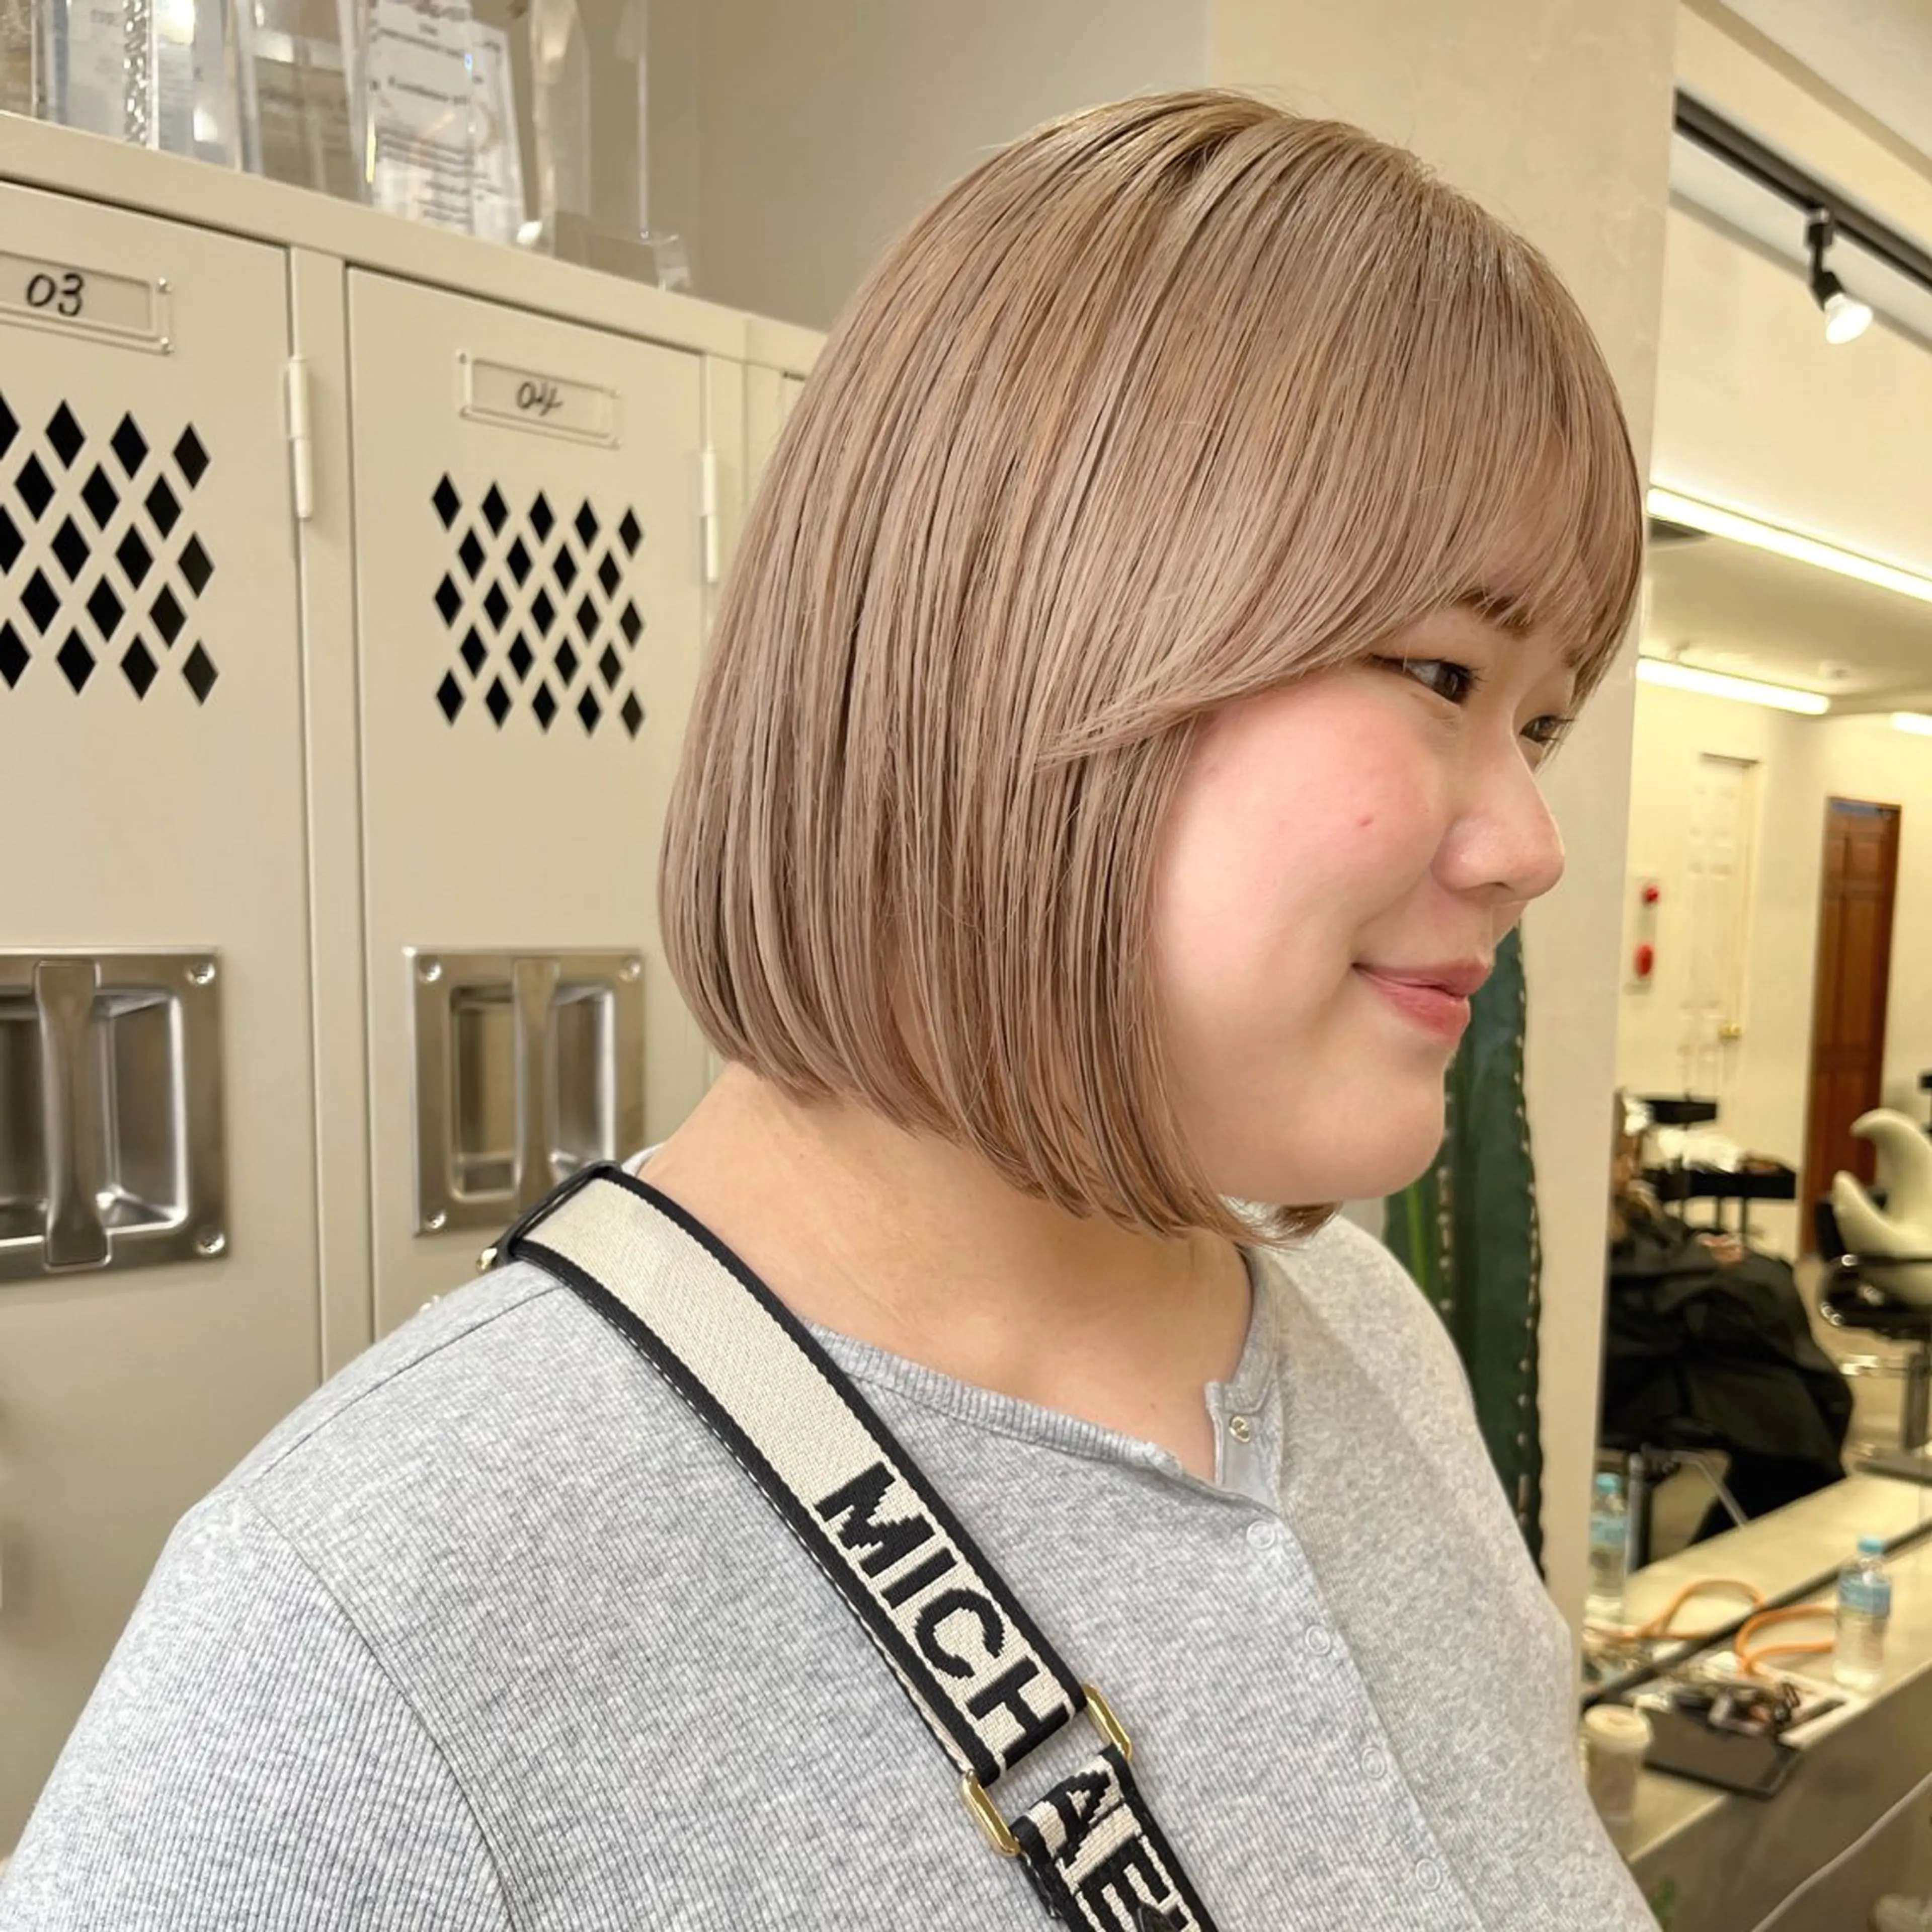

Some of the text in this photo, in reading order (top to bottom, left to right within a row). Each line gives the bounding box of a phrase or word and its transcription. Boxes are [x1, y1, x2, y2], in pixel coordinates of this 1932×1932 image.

[27, 272, 84, 317] 03
[516, 381, 564, 417] 04
[1029, 1769, 1189, 1932] AE
